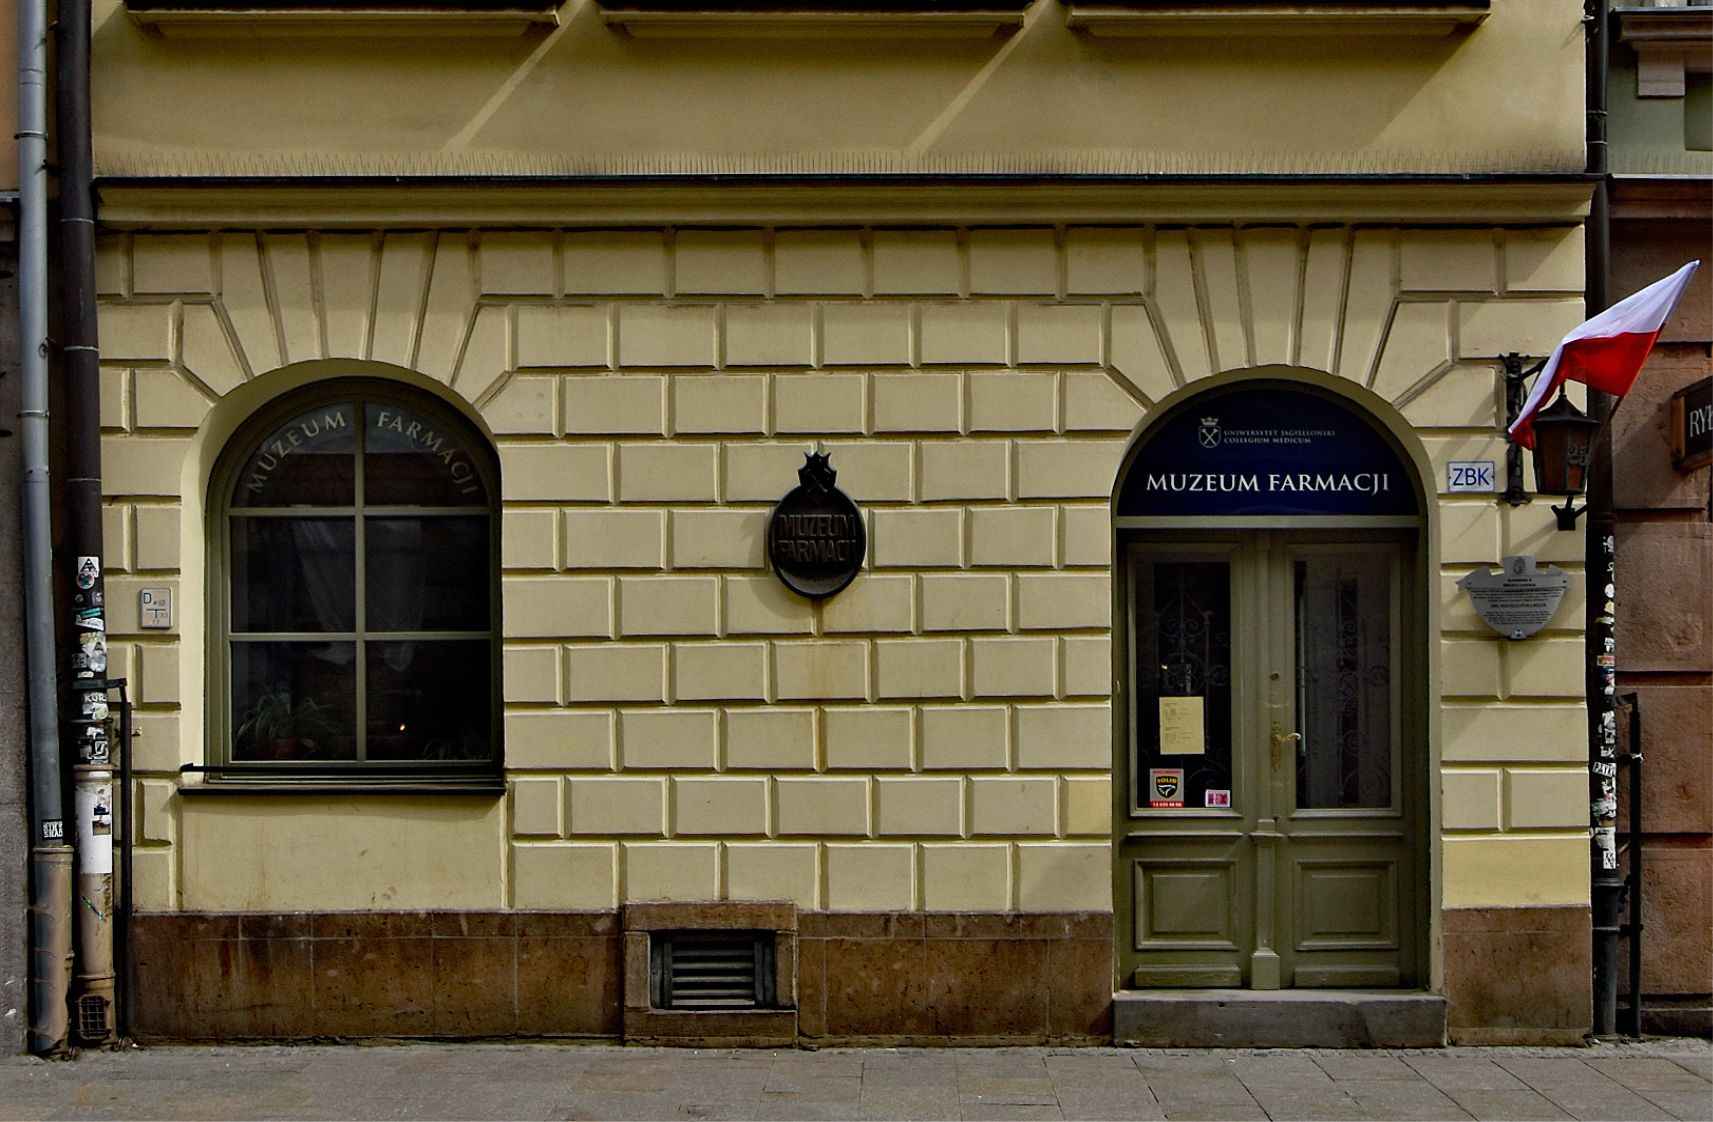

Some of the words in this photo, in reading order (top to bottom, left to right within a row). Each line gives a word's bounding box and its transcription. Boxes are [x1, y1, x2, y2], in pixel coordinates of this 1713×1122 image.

[247, 411, 347, 494] MUZEUM
[377, 411, 480, 495] FARMACJI
[1146, 473, 1260, 492] MUZEUM
[1268, 473, 1389, 496] FARMACJI
[1452, 467, 1491, 486] ZBK
